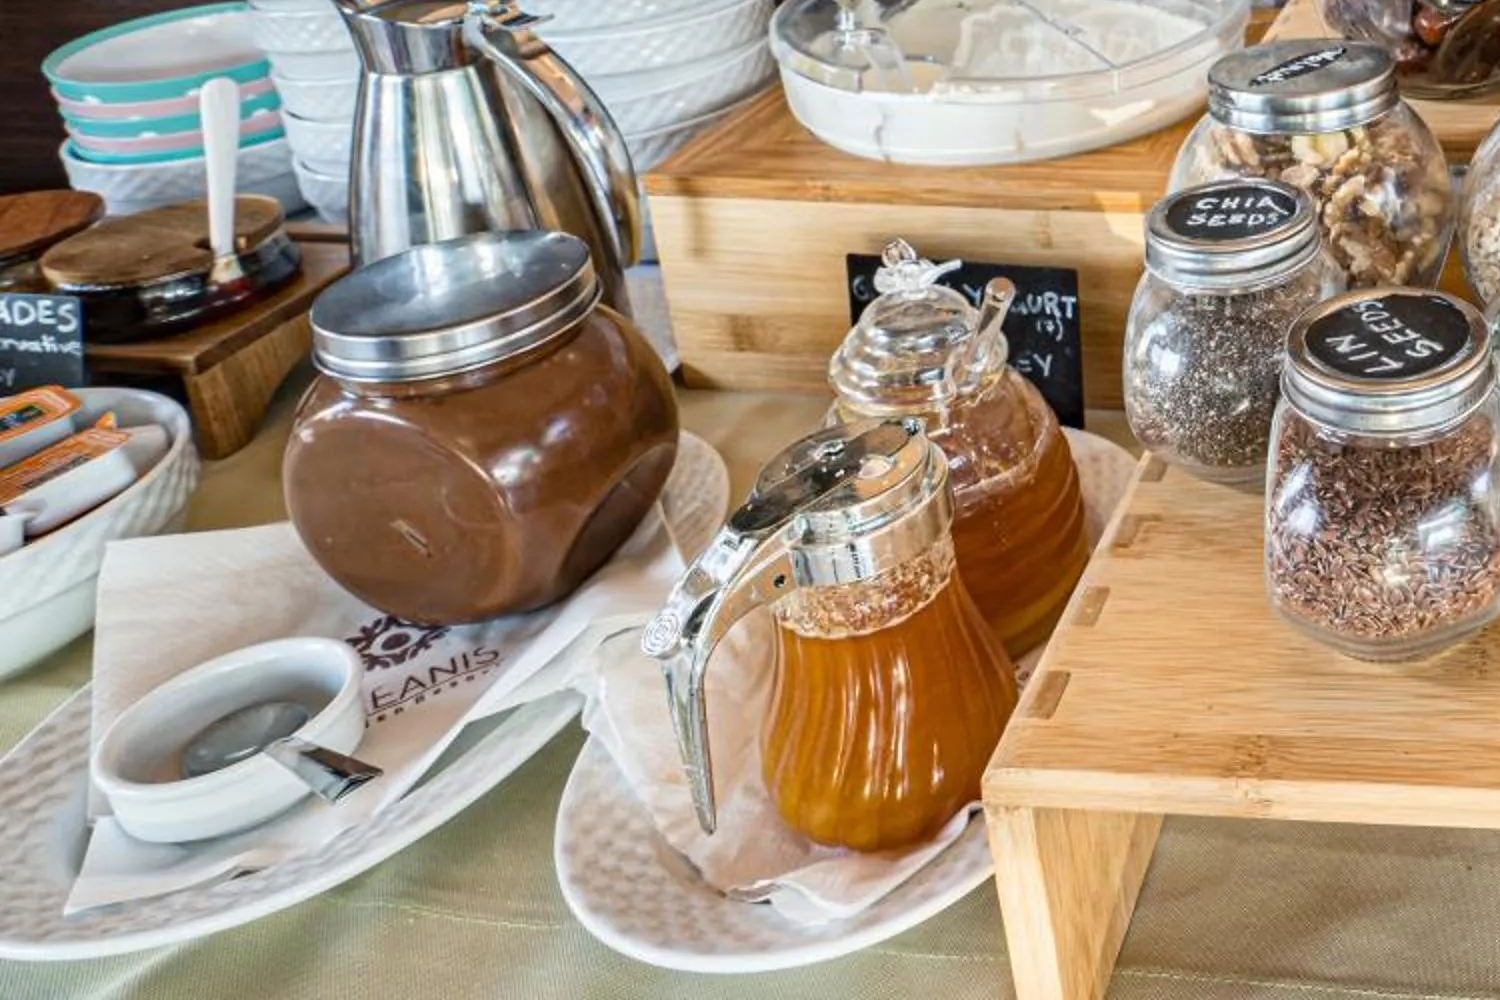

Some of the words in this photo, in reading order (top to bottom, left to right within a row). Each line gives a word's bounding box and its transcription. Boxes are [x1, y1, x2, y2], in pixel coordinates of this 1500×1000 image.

[1186, 212, 1280, 228] SEEDS
[1195, 196, 1289, 215] CHIA
[1352, 301, 1445, 358] SEEDS
[1324, 333, 1405, 373] LIN
[371, 645, 500, 709] EANIS
